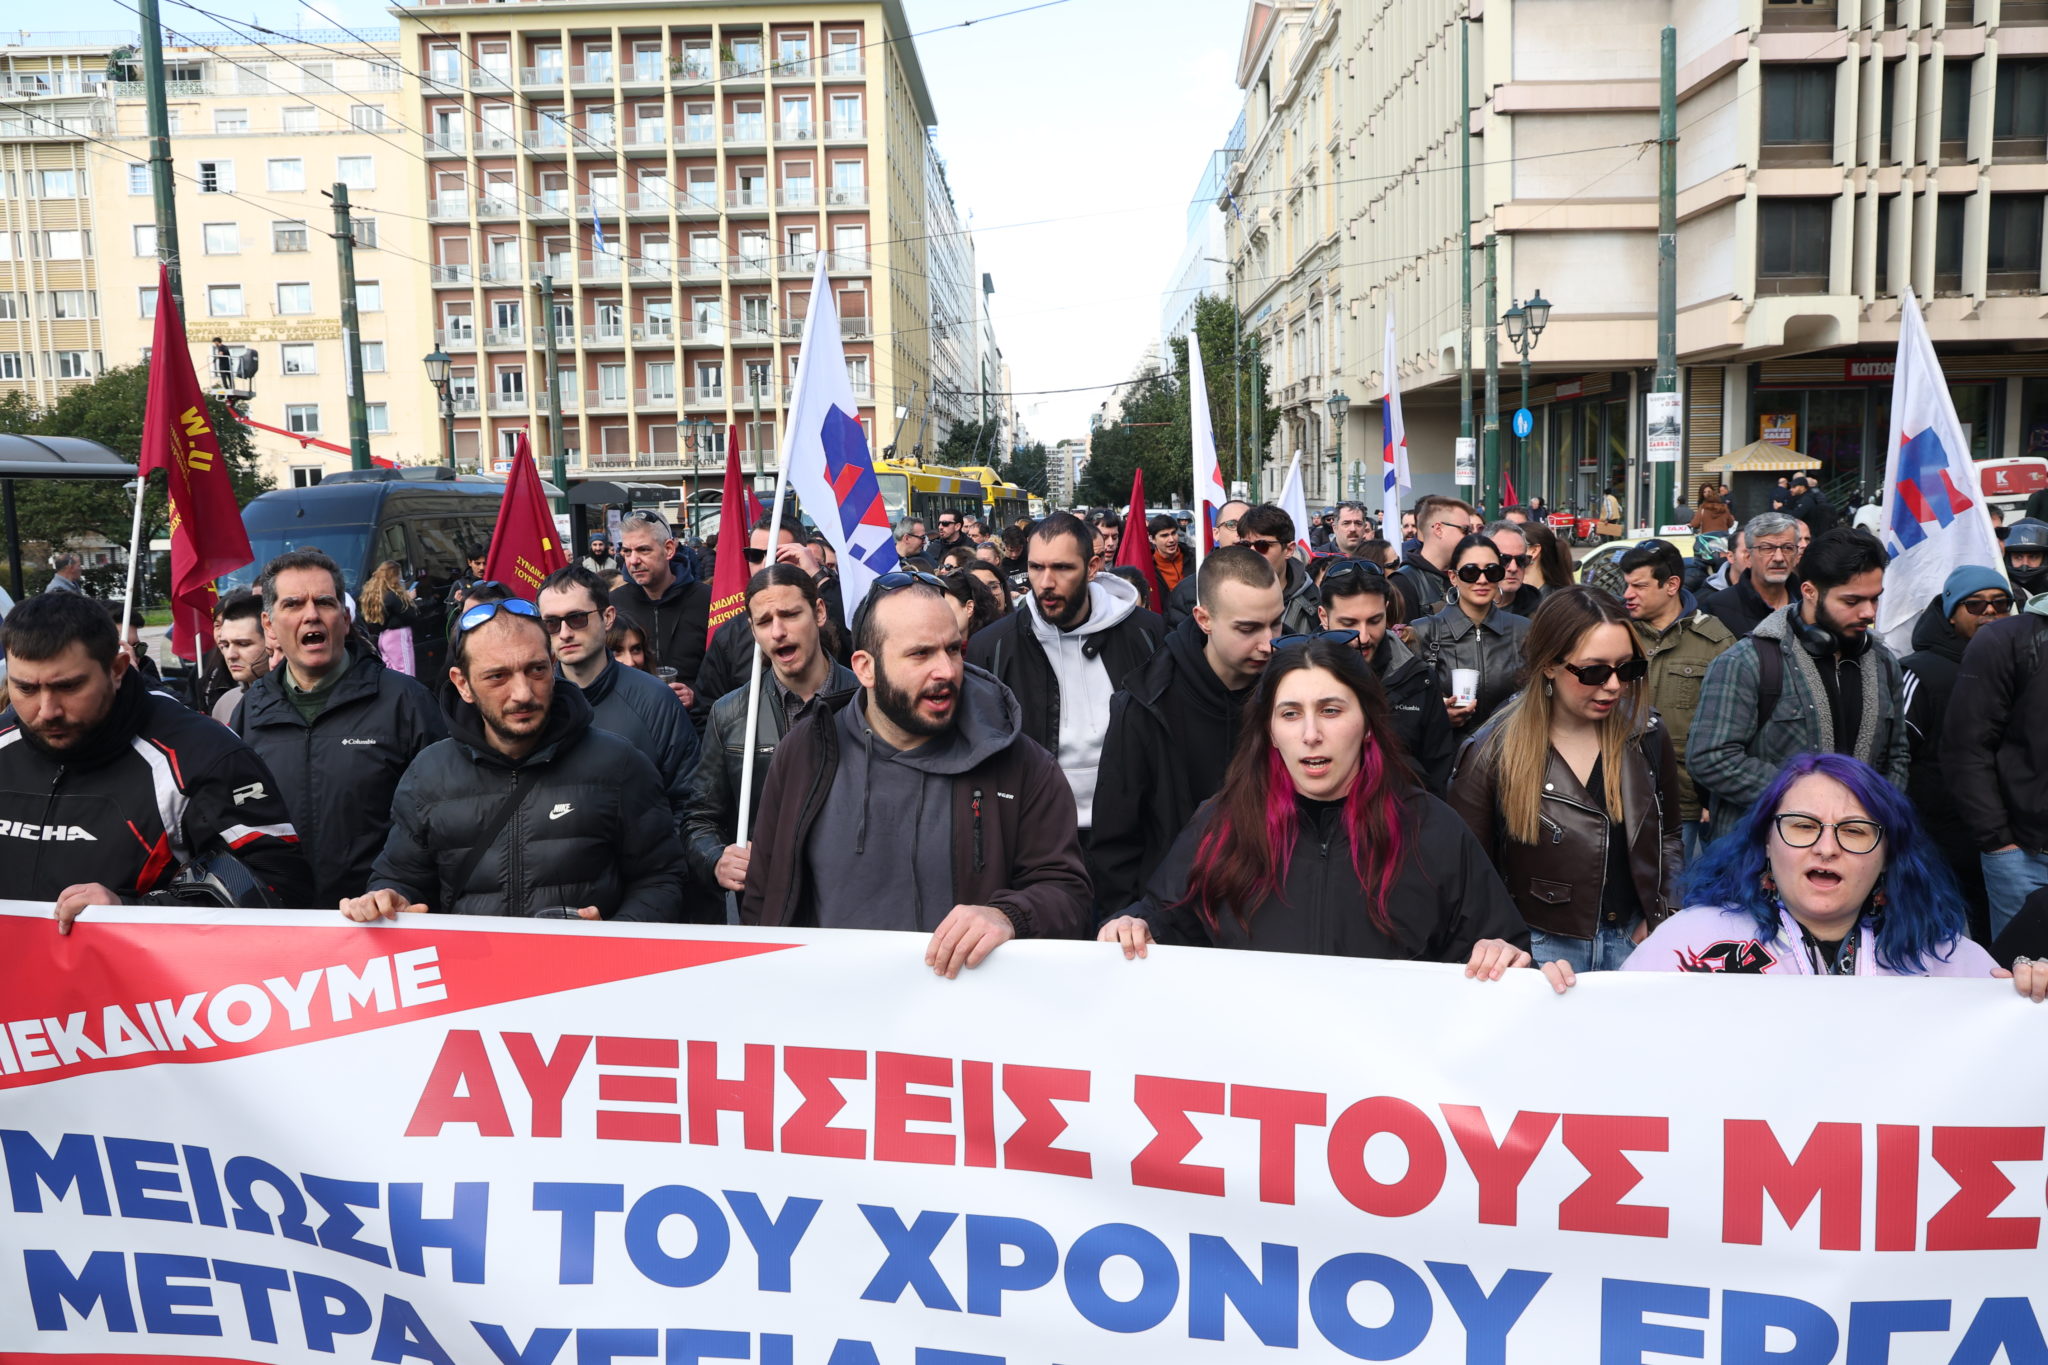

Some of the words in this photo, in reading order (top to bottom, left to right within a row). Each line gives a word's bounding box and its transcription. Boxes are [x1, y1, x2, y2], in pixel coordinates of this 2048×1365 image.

[594, 460, 651, 468] ΥΠΟΥΡΓΕΙΟ
[654, 459, 718, 467] ΕΣΩΤΕΡΚΩΝ
[1996, 471, 2008, 483] K
[0, 819, 98, 841] RICHA
[553, 803, 571, 813] NIKE
[0, 945, 448, 1075] ΙΕΚΔΙΚΟΥΜΕ
[409, 1029, 1093, 1179] ΑΥΞΗΣΕΙΣ
[1130, 1074, 1670, 1239] ΣΤΟΥΣ
[1722, 1119, 2048, 1252] ΜΙΣ
[0, 1129, 489, 1285] ΜΕΙΩΣΗ
[533, 1182, 823, 1293] ΤΟΥ
[857, 1203, 1552, 1365] ΧΡΟΝΟΥ
[23, 1249, 455, 1365] ΜΕΤΡΑ
